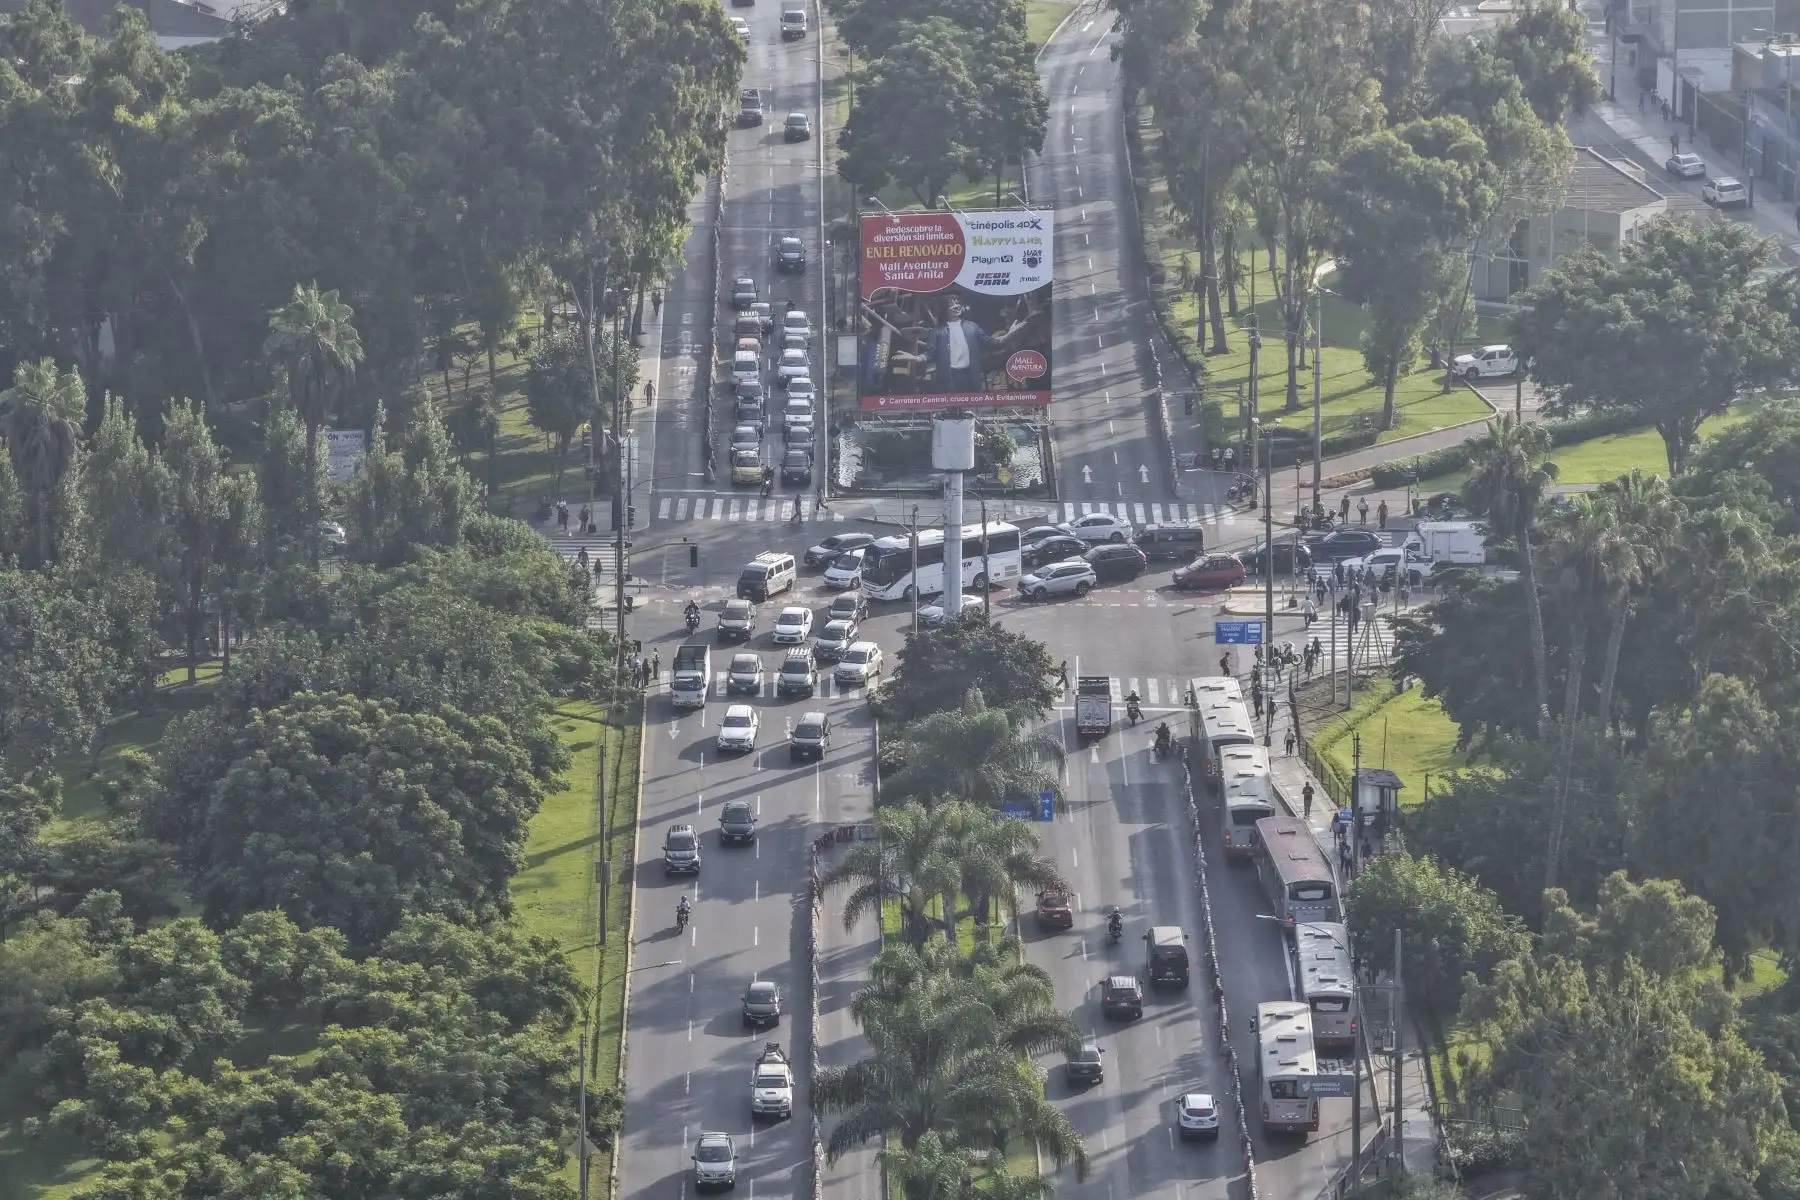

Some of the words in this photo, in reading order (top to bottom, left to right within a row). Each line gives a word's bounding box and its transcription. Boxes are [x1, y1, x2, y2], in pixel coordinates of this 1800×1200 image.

[886, 225, 933, 234] Redescubre
[934, 224, 942, 232] la
[971, 220, 1015, 231] cinépolis
[912, 233, 925, 241] sin
[866, 247, 882, 258] EN
[883, 246, 898, 258] EL
[899, 243, 962, 257] RENOVADO
[879, 262, 901, 271] Mall
[903, 261, 949, 270] Aventura
[884, 272, 914, 280] Santa
[917, 270, 944, 279] Anita
